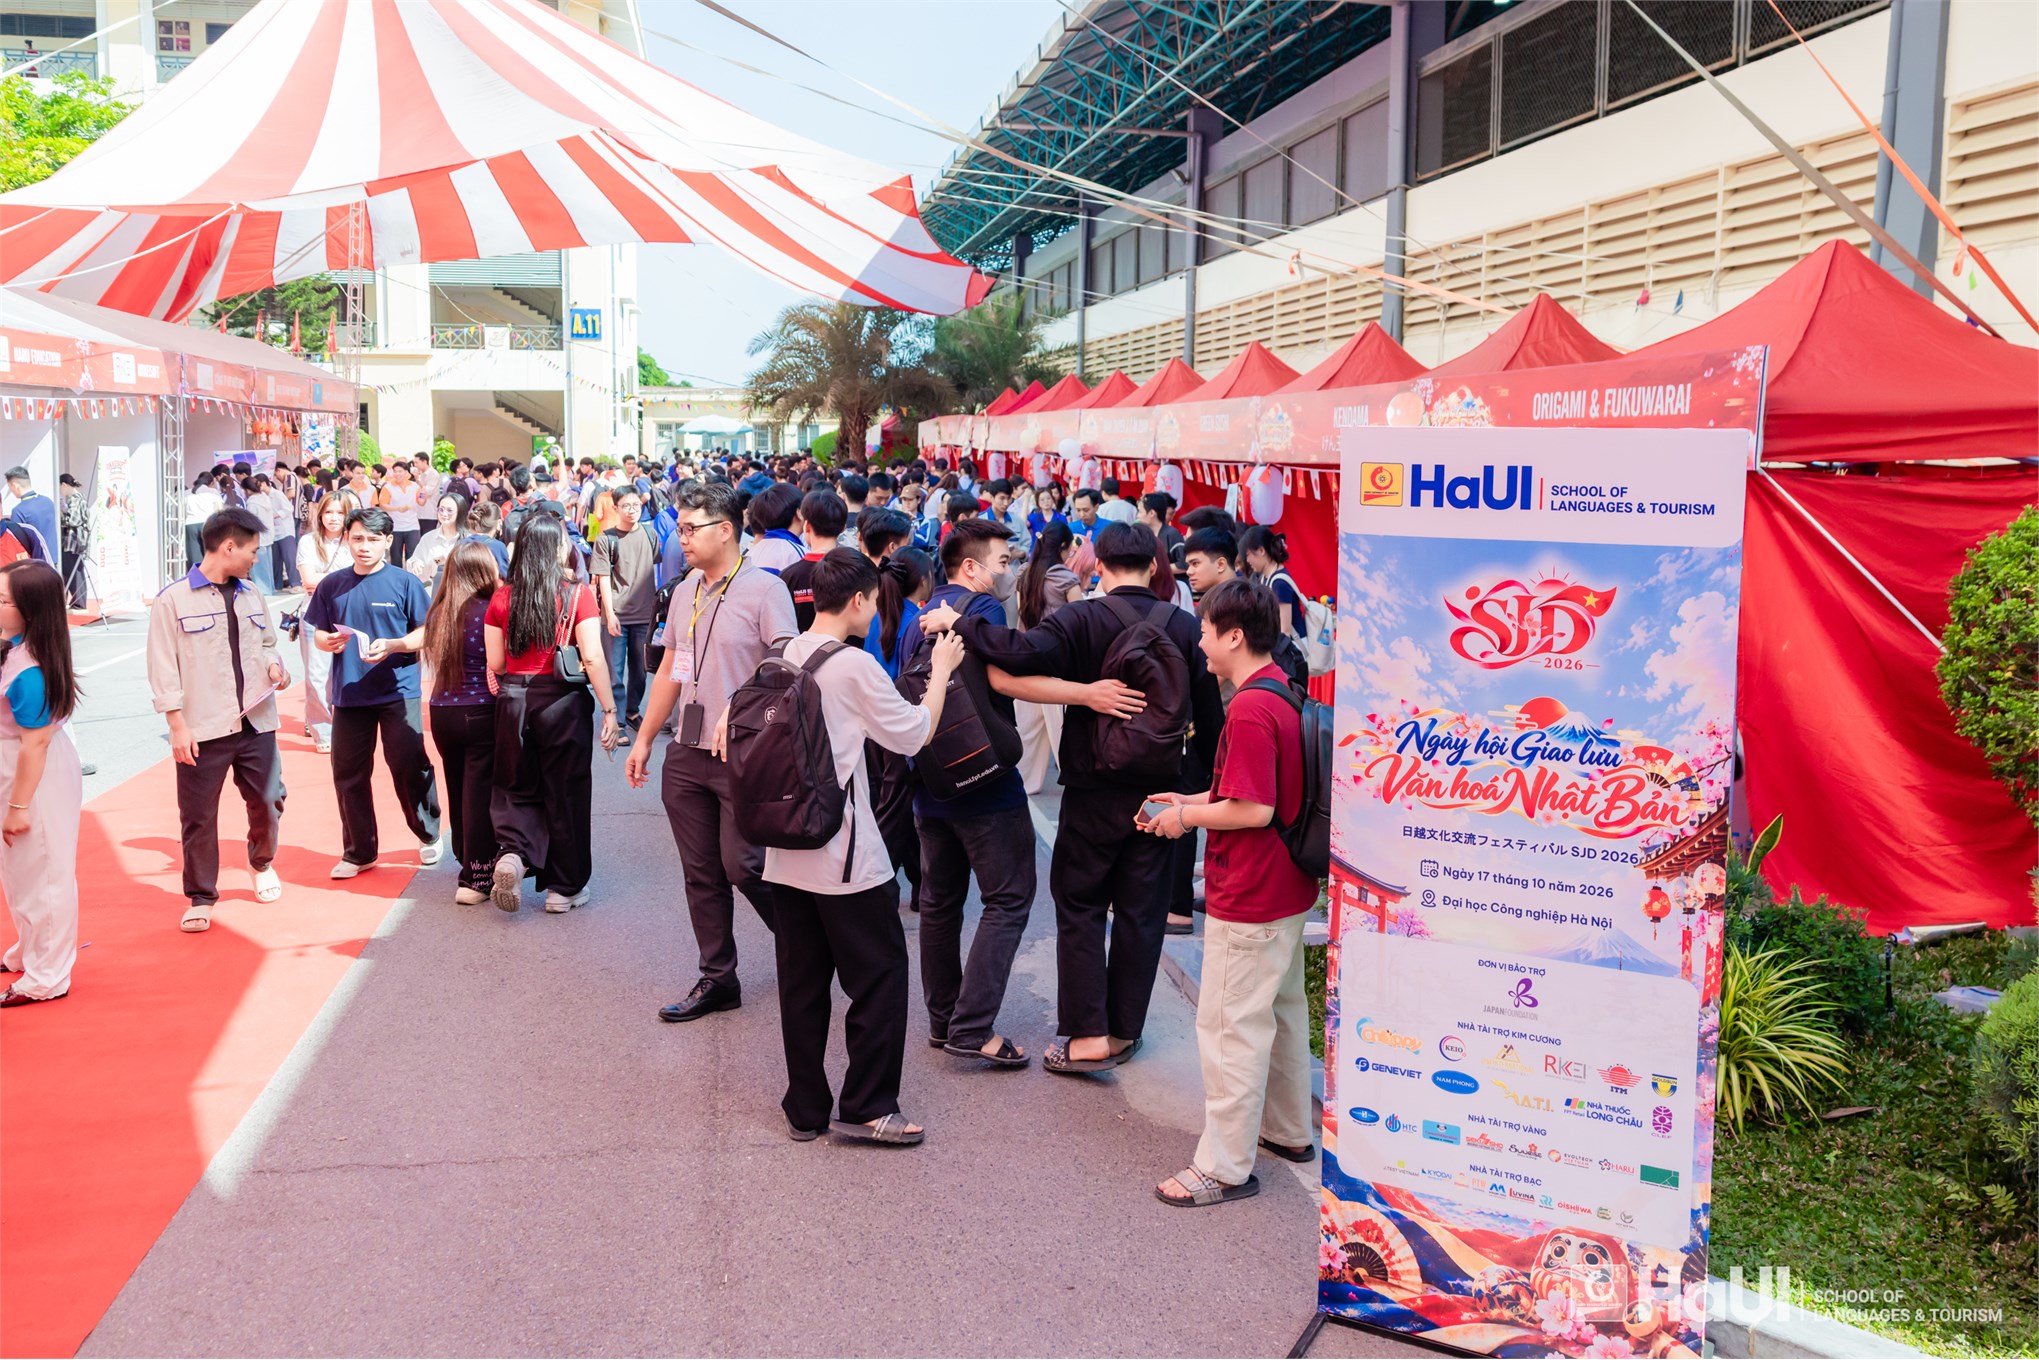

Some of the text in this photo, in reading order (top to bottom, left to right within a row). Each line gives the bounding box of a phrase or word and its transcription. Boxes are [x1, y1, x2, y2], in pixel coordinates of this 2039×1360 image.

[572, 314, 599, 334] A.11
[1533, 384, 1692, 421] ORIGAMI & FUKUWARAI
[1334, 405, 1368, 427] KENDAMA
[1410, 463, 1532, 511] HaUI
[1550, 484, 1628, 498] SCHOOL OF
[1550, 500, 1715, 516] LANGUAGES & TOURISM
[1447, 588, 1598, 671] SJD
[1544, 657, 1583, 671] 2026
[1395, 718, 1622, 769] Ngày hội Giao lưu
[1364, 753, 1690, 829] Văn hoá Nhật Bản
[1402, 825, 1639, 865] 日越文化交流フェスティバル SJD 2026
[1443, 866, 1614, 898] Ngày 17 tháng 10 năm 2026
[1442, 896, 1613, 930] Đại học Công nghiệp Hà Nội
[1478, 959, 1546, 978] ĐƠN VỊ BẢO TRỢ
[1457, 1020, 1562, 1046] NHÀ TÀI TRỢ KIM CƯƠNG
[1445, 1044, 1464, 1054] KEIO
[1372, 1062, 1422, 1080] GENEVIET
[1436, 1076, 1475, 1088] NAM PHONG
[1610, 1086, 1628, 1095] ITM
[1586, 1101, 1631, 1116] NHÀ THUỐC
[1586, 1110, 1643, 1128] LONG CHÂU
[1468, 1114, 1547, 1136] NHÀ TÀI TRỢ VÀNG
[1470, 1164, 1542, 1186] NHÀ TÀI TRỢ BẠC
[1612, 1163, 1635, 1174] HARU
